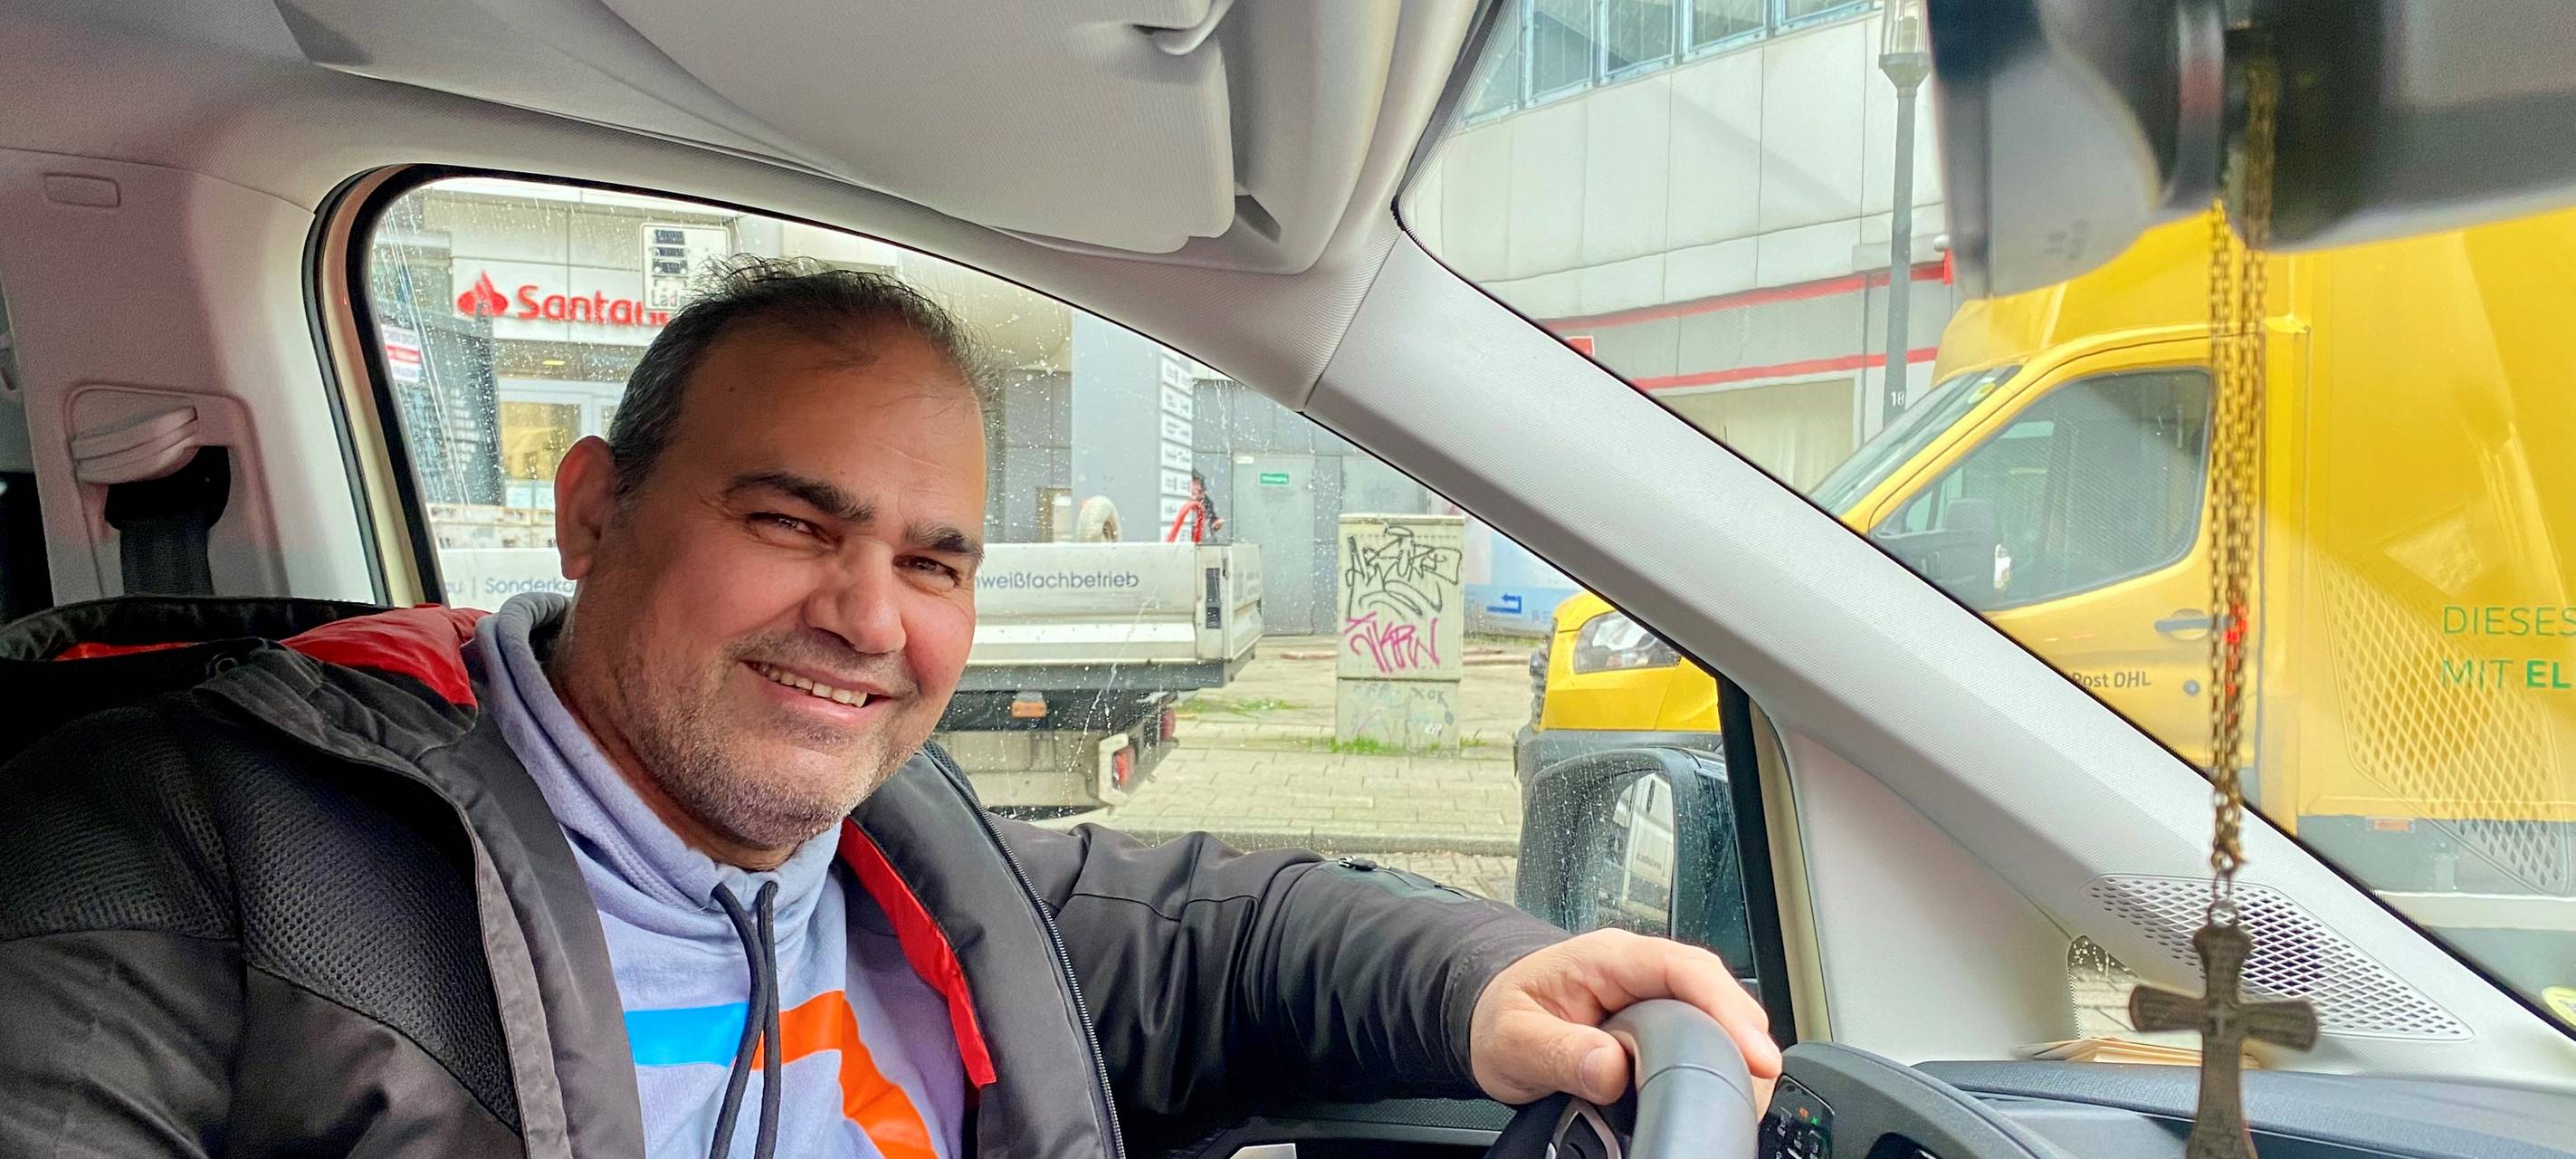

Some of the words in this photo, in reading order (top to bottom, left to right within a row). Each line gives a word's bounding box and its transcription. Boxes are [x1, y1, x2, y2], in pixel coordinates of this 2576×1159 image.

[1891, 390, 1905, 407] 18
[2443, 606, 2576, 637] DIESES
[2113, 671, 2151, 688] DHL
[2442, 659, 2514, 690] MIT
[2526, 659, 2572, 689] EL
